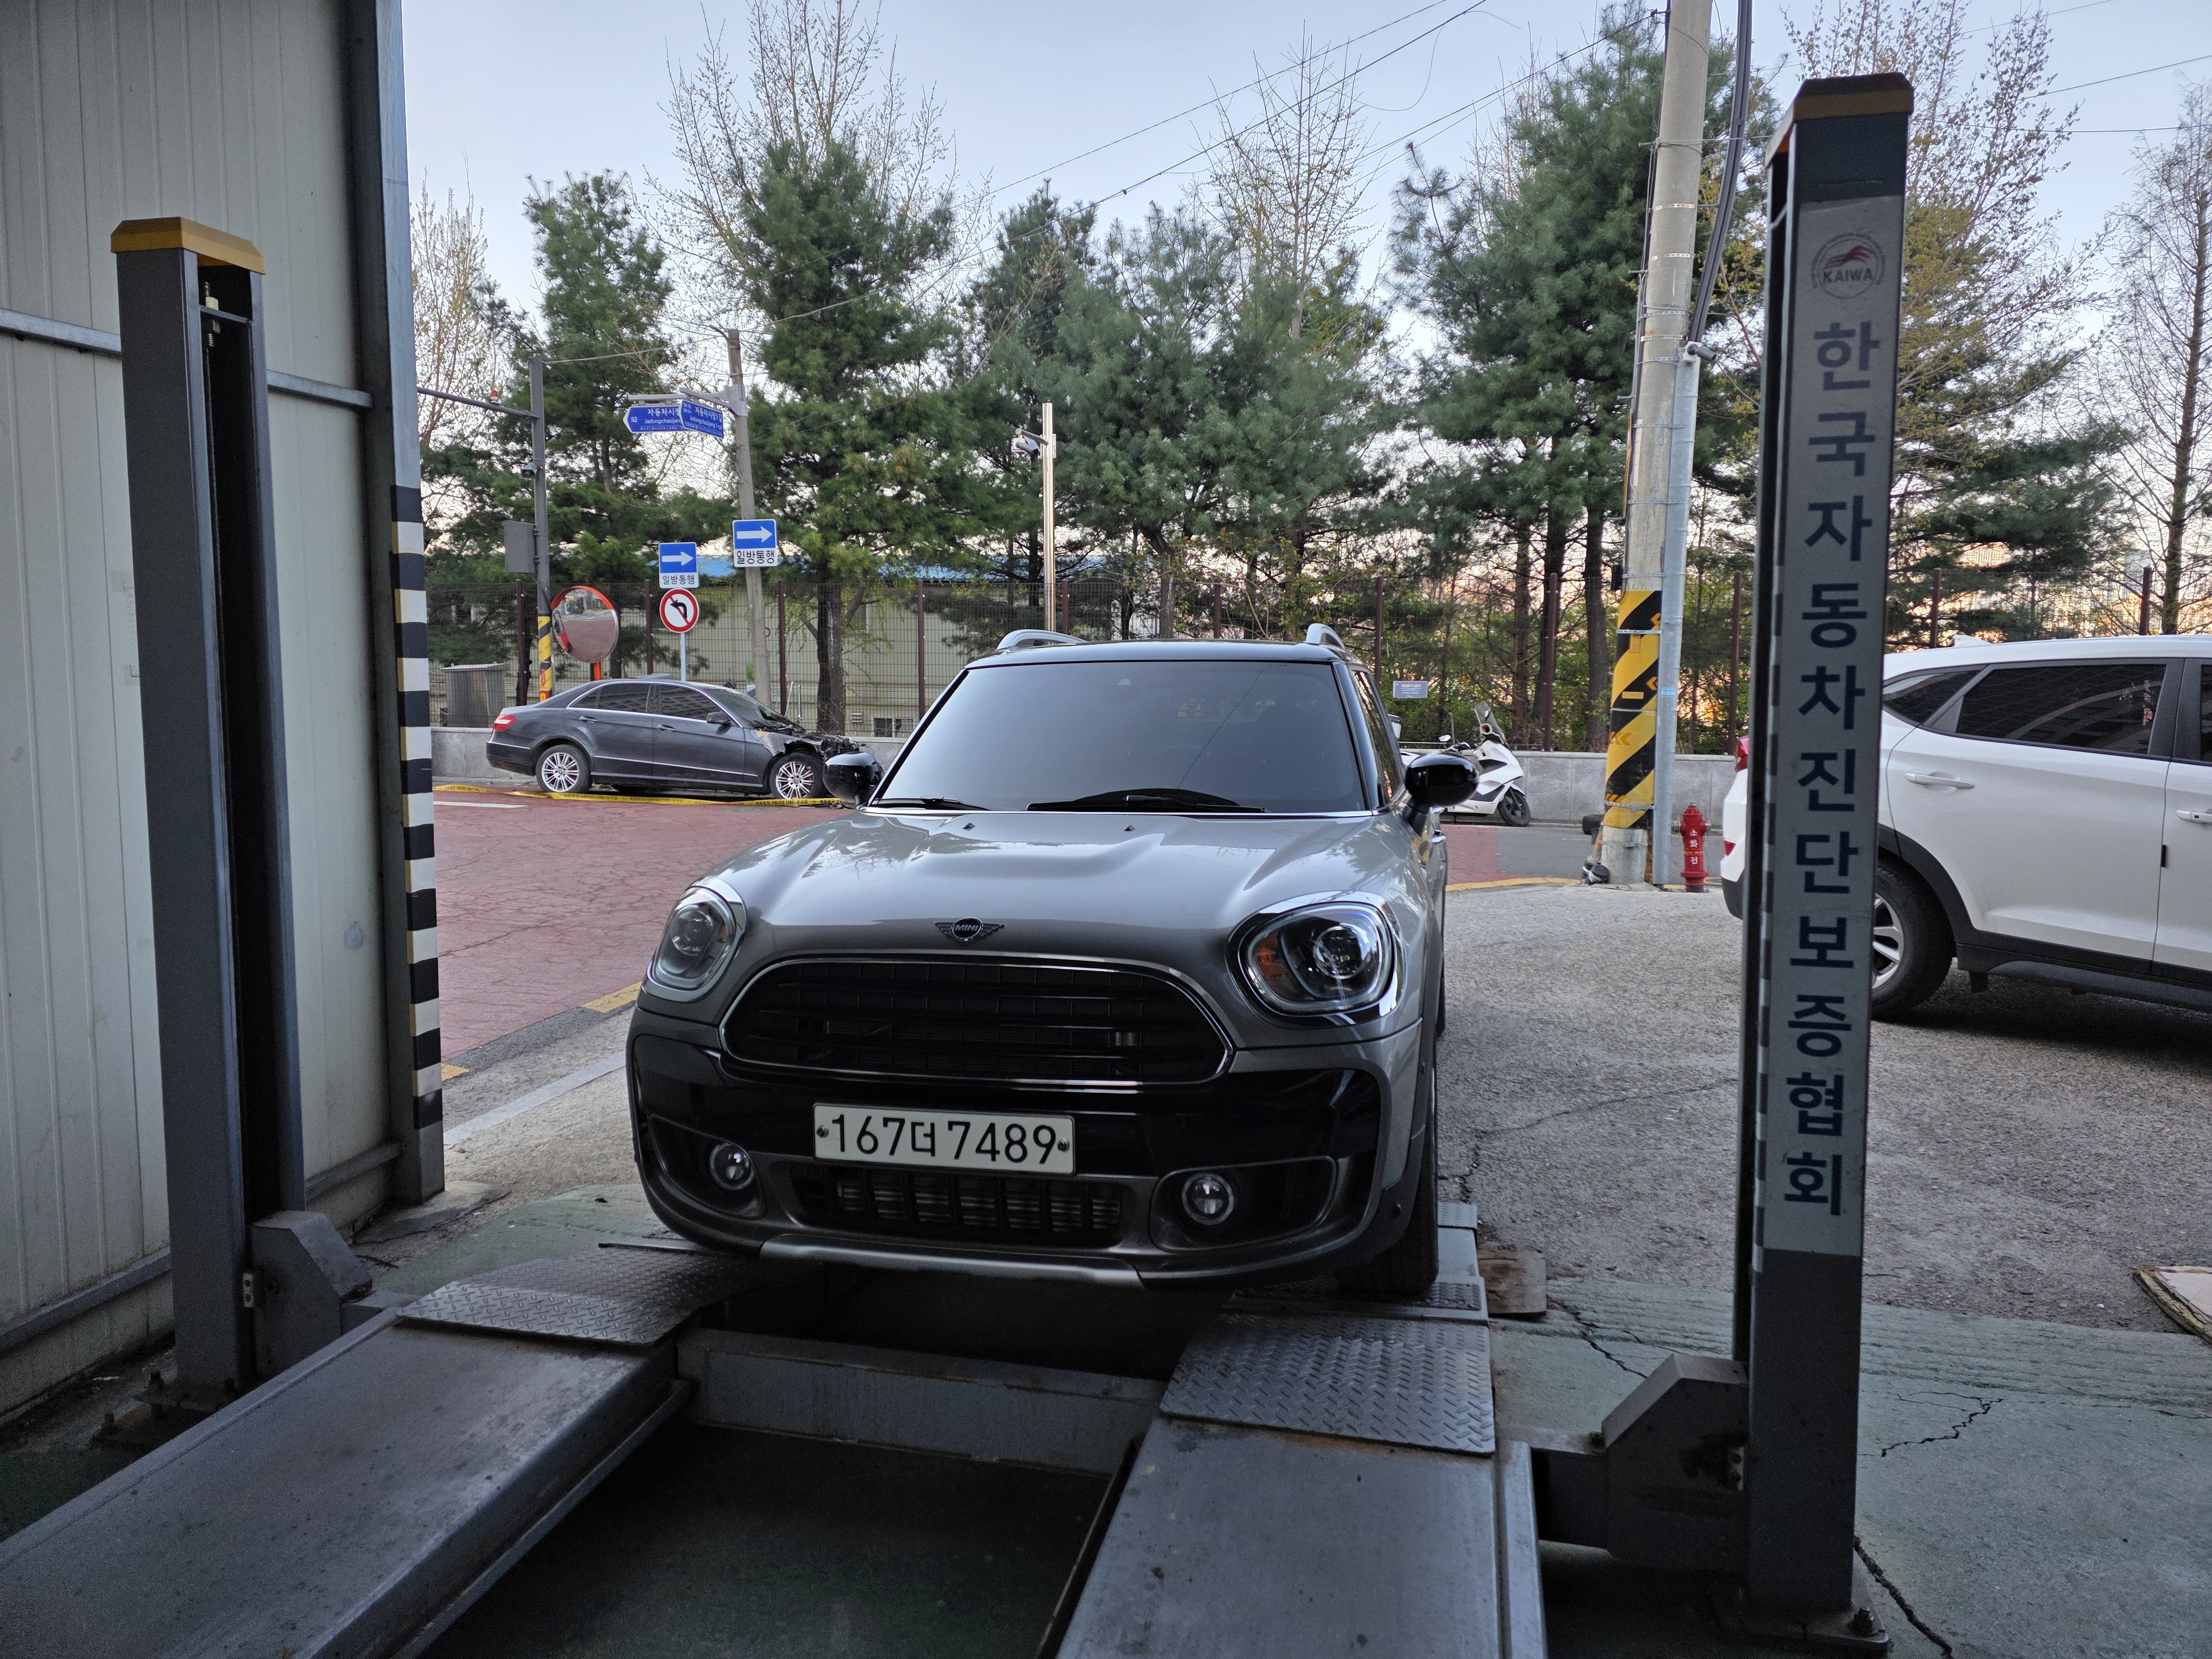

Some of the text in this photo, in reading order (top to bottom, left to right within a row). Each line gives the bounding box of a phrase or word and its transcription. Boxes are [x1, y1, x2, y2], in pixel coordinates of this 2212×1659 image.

[1823, 268, 1872, 283] KAIWA
[736, 550, 775, 565] 일방통행
[662, 574, 695, 585] 일방통행
[1784, 321, 1880, 1216] 한국자동차진단보증협회
[1690, 829, 1699, 864] 소화전
